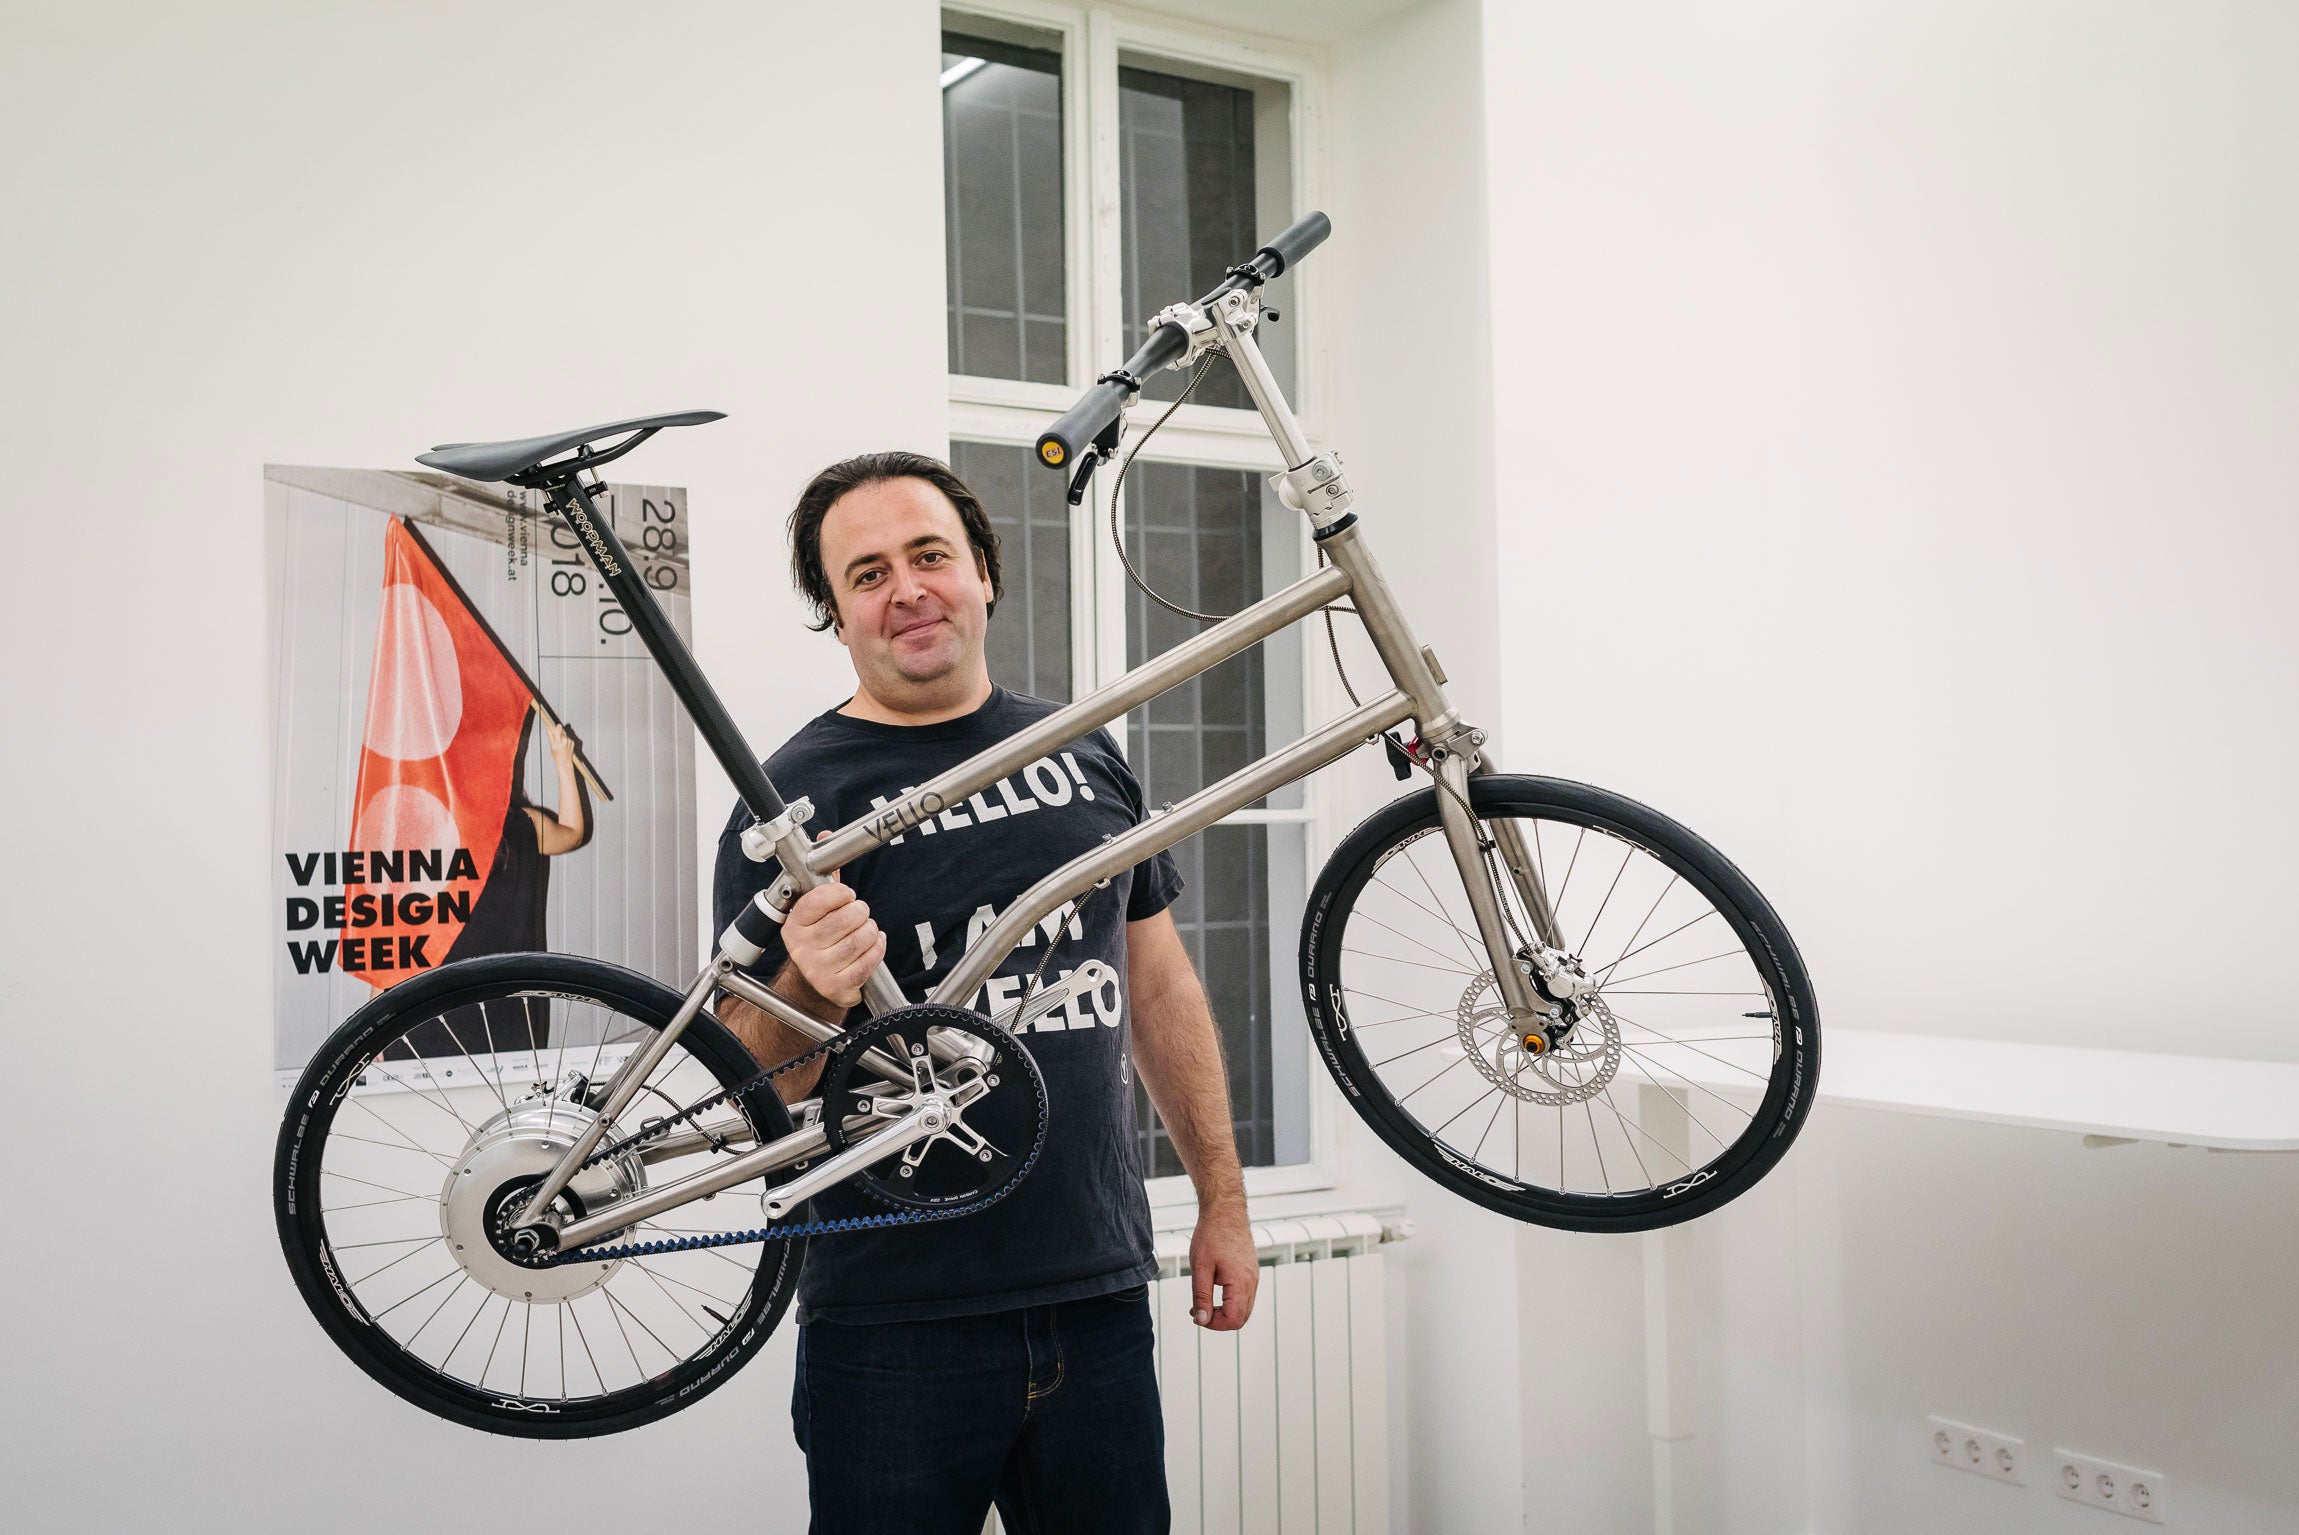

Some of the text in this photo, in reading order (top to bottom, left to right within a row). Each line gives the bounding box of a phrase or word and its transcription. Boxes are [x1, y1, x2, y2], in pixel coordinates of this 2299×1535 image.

[506, 490, 518, 582] deignweek.at
[551, 523, 587, 597] 018
[565, 497, 622, 577] WOODMAN
[862, 791, 945, 843] VELLO
[284, 848, 480, 886] VIENNA
[286, 890, 473, 931] DESIGN
[914, 921, 938, 971] I
[287, 934, 432, 975] WEEK
[1308, 912, 1361, 1098] SCHWALBE DURANO
[288, 1113, 310, 1216] SCHWALBE
[319, 1025, 375, 1087] DURANO
[1786, 1051, 1803, 1120] DURANO
[679, 1237, 791, 1398] CHWALBE DURANO
